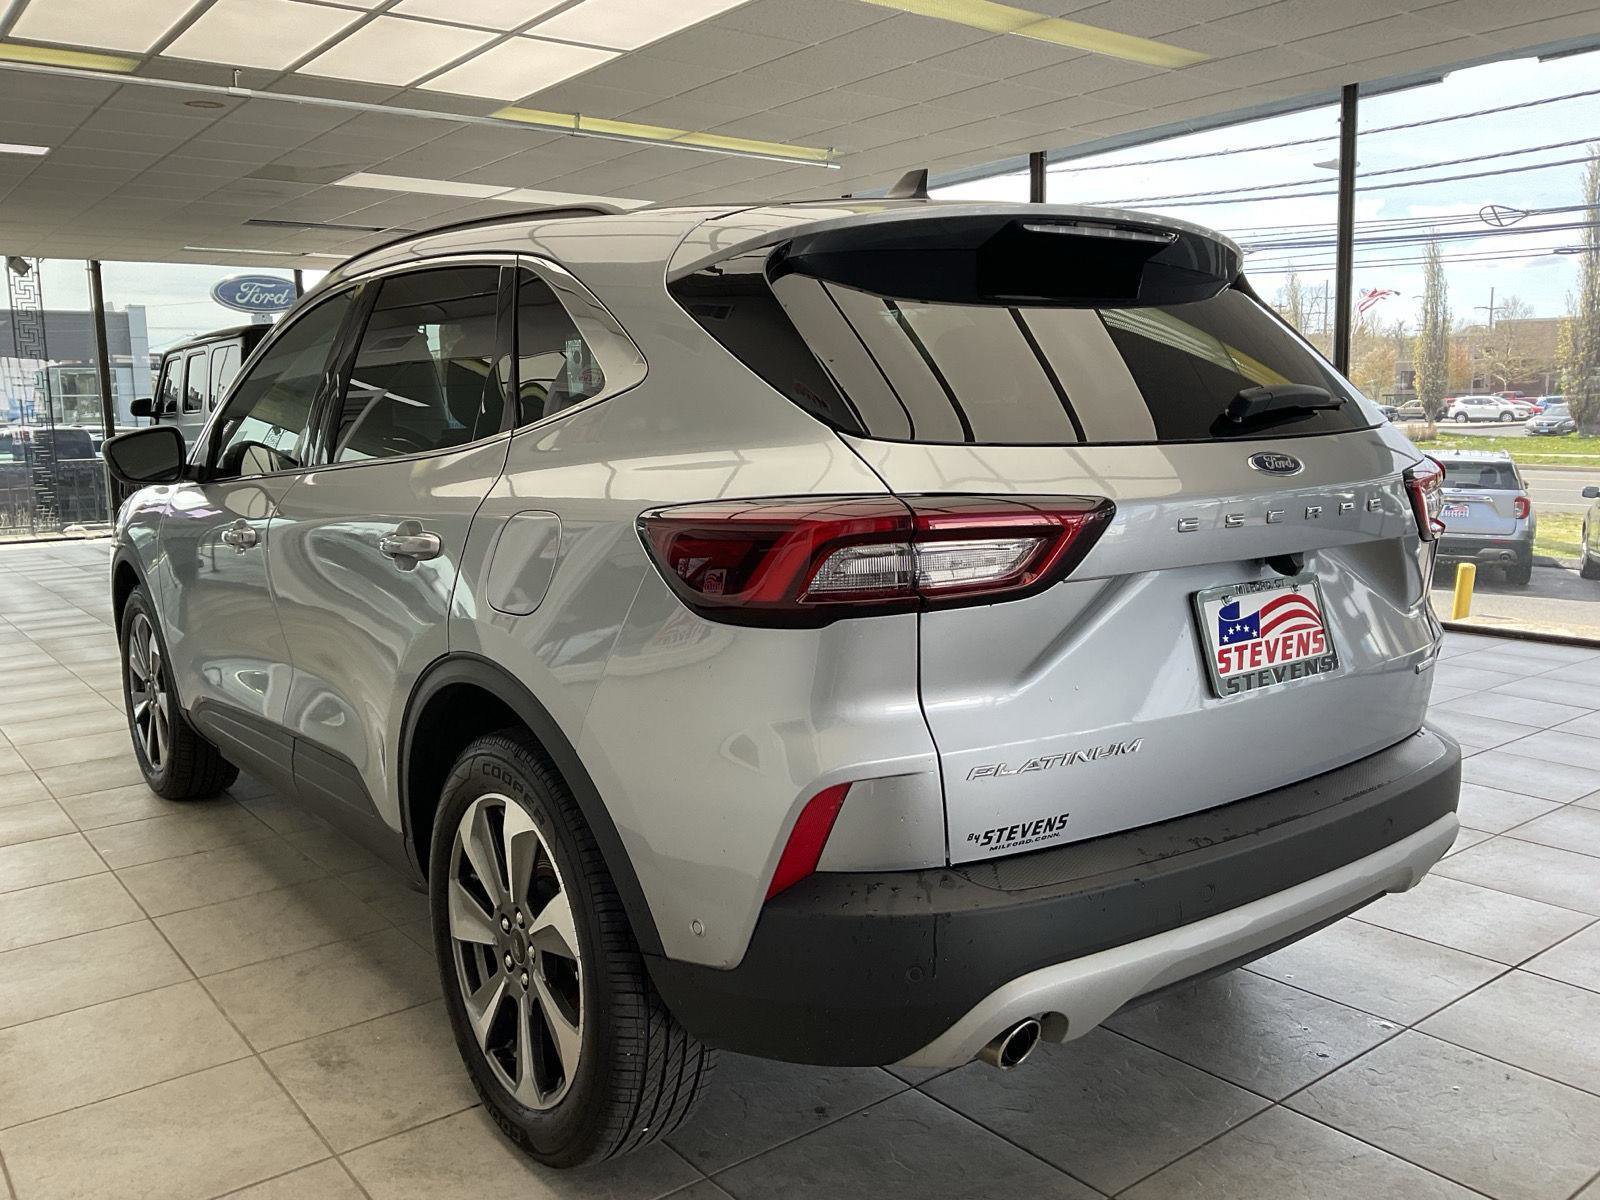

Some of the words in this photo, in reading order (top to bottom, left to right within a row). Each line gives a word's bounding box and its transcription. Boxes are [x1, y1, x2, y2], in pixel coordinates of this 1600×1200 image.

[236, 282, 288, 305] Ford
[1263, 454, 1295, 469] Ford
[1177, 496, 1383, 533] ESCAPE
[1217, 629, 1325, 674] STEVENS
[1226, 655, 1335, 695] STEVENS
[966, 737, 1145, 781] PLATINUM
[980, 813, 1069, 846] STEVENS
